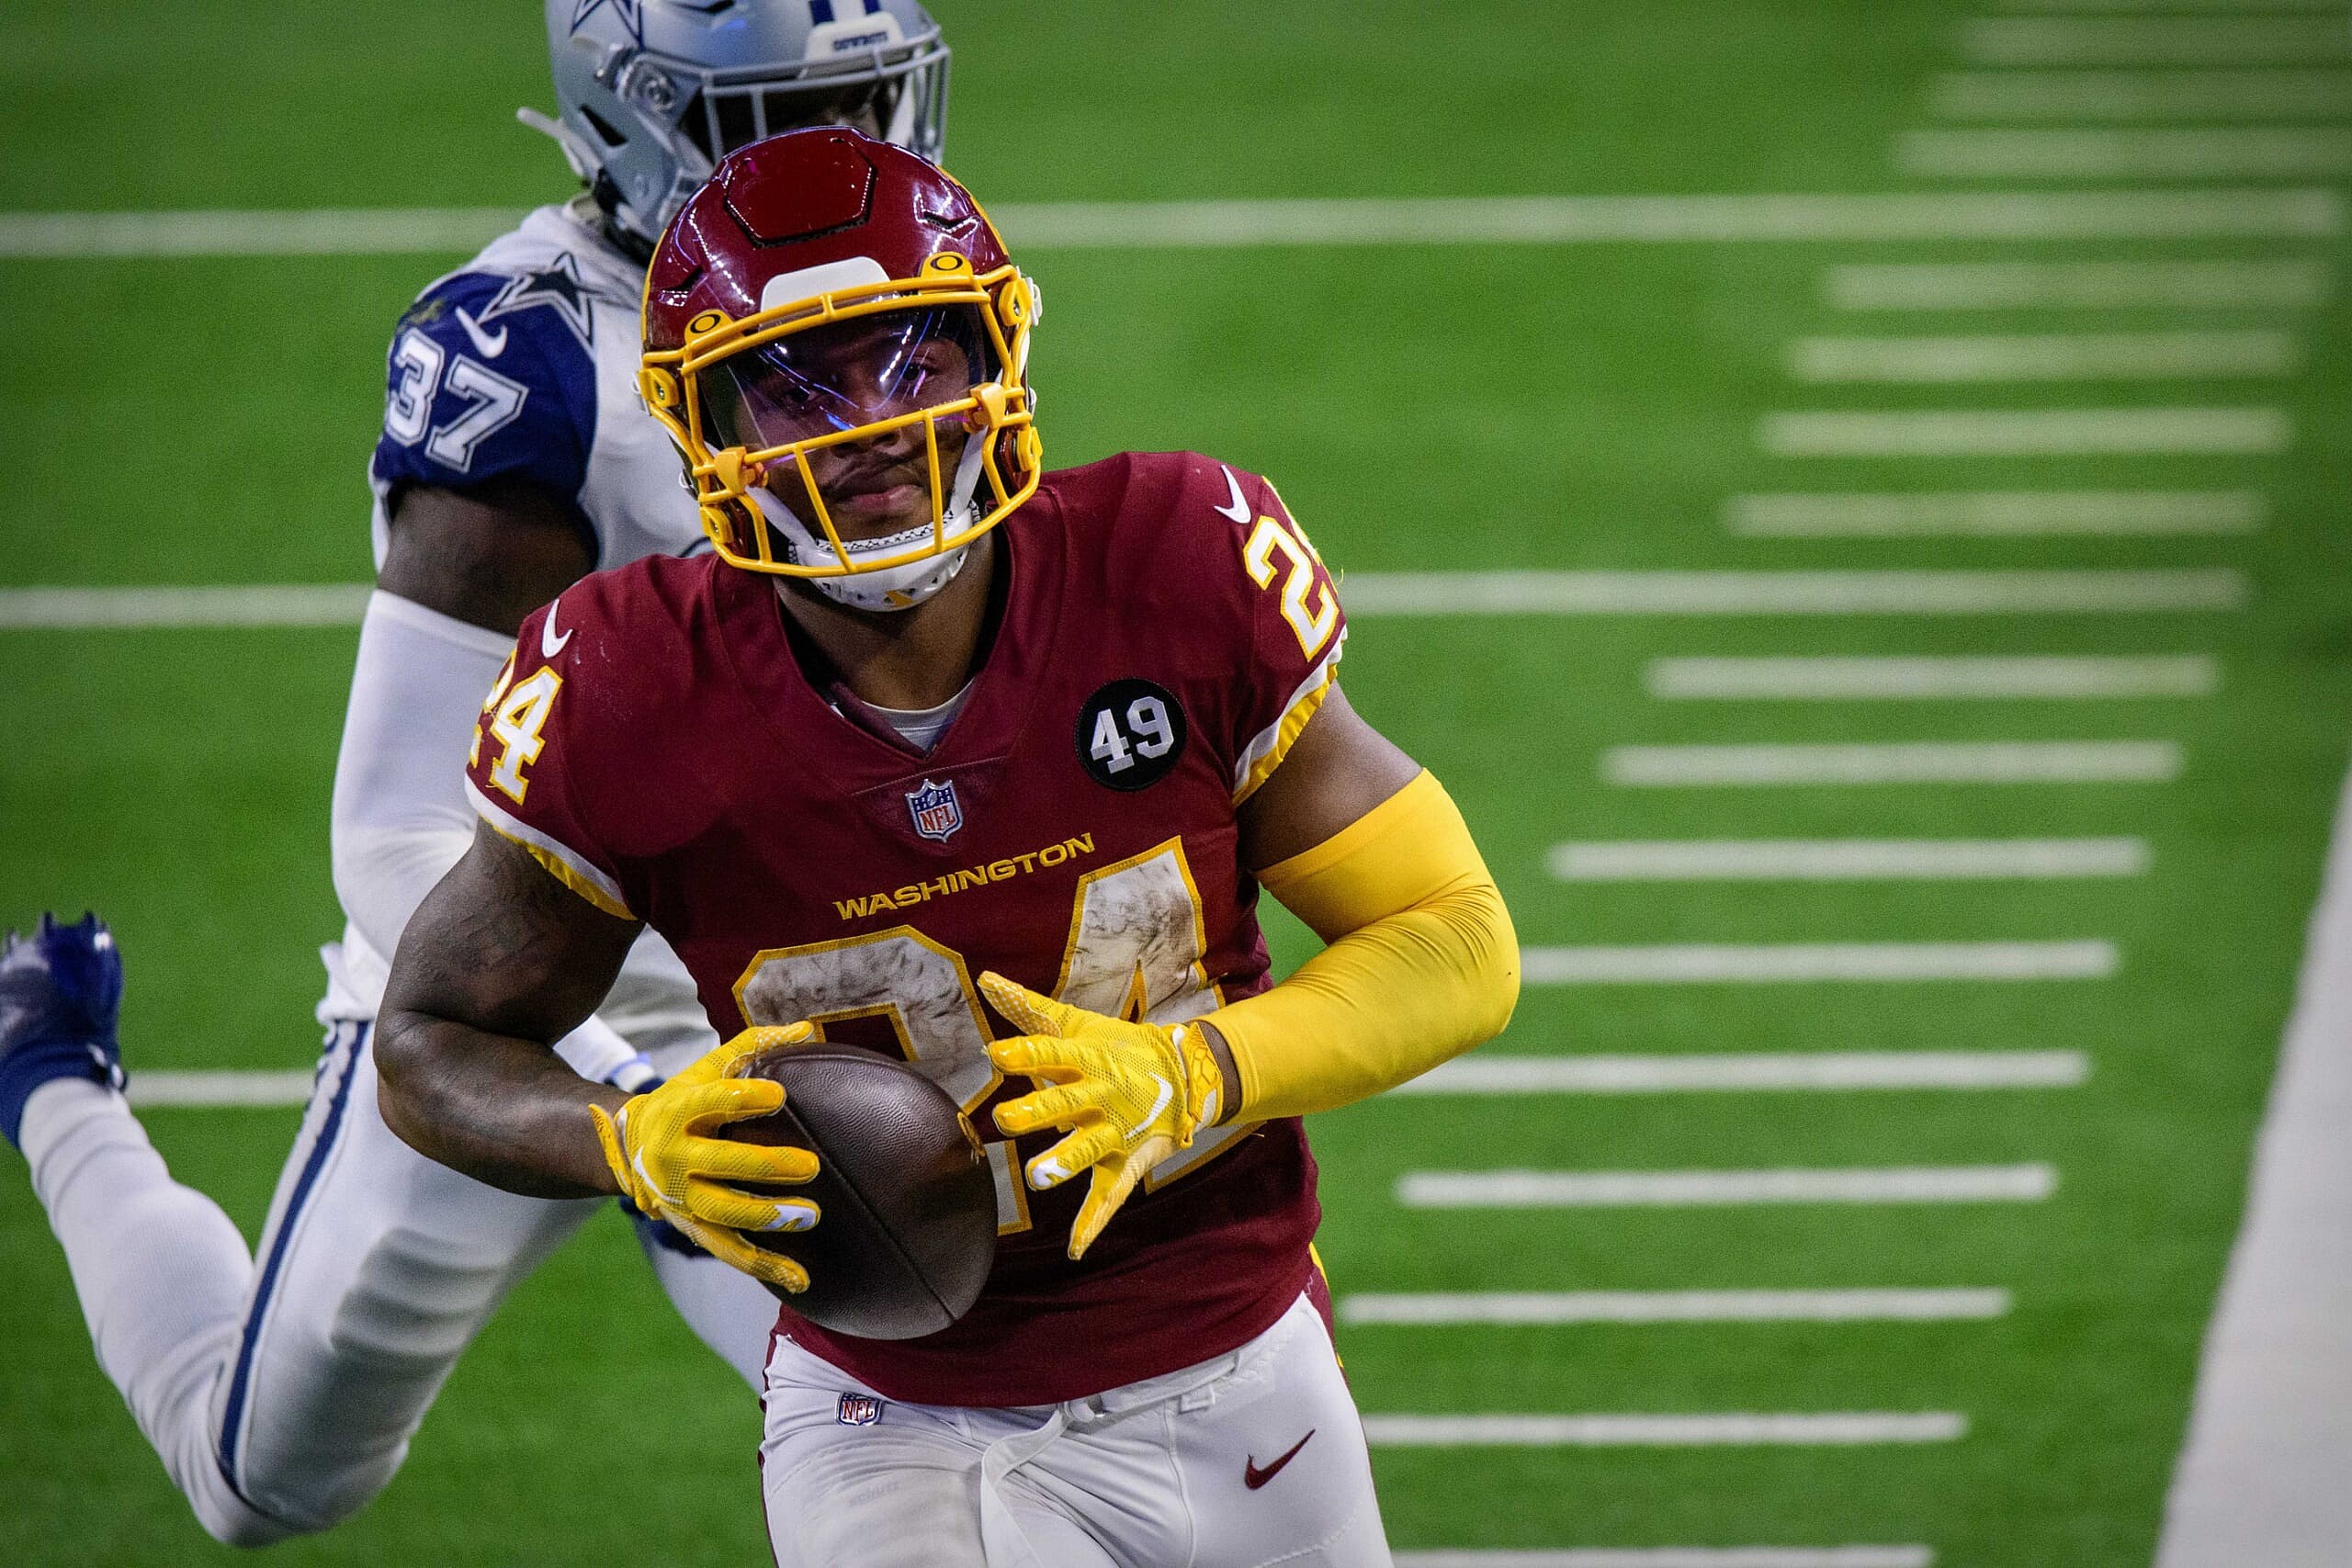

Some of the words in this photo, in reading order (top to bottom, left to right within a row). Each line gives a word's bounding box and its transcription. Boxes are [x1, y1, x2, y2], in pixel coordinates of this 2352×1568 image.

[385, 327, 529, 473] 37
[1243, 475, 1340, 662] 2
[1091, 696, 1174, 774] 49
[920, 806, 956, 831] NFL
[832, 832, 1095, 920] WASHINGTON
[842, 1401, 874, 1422] NFL
